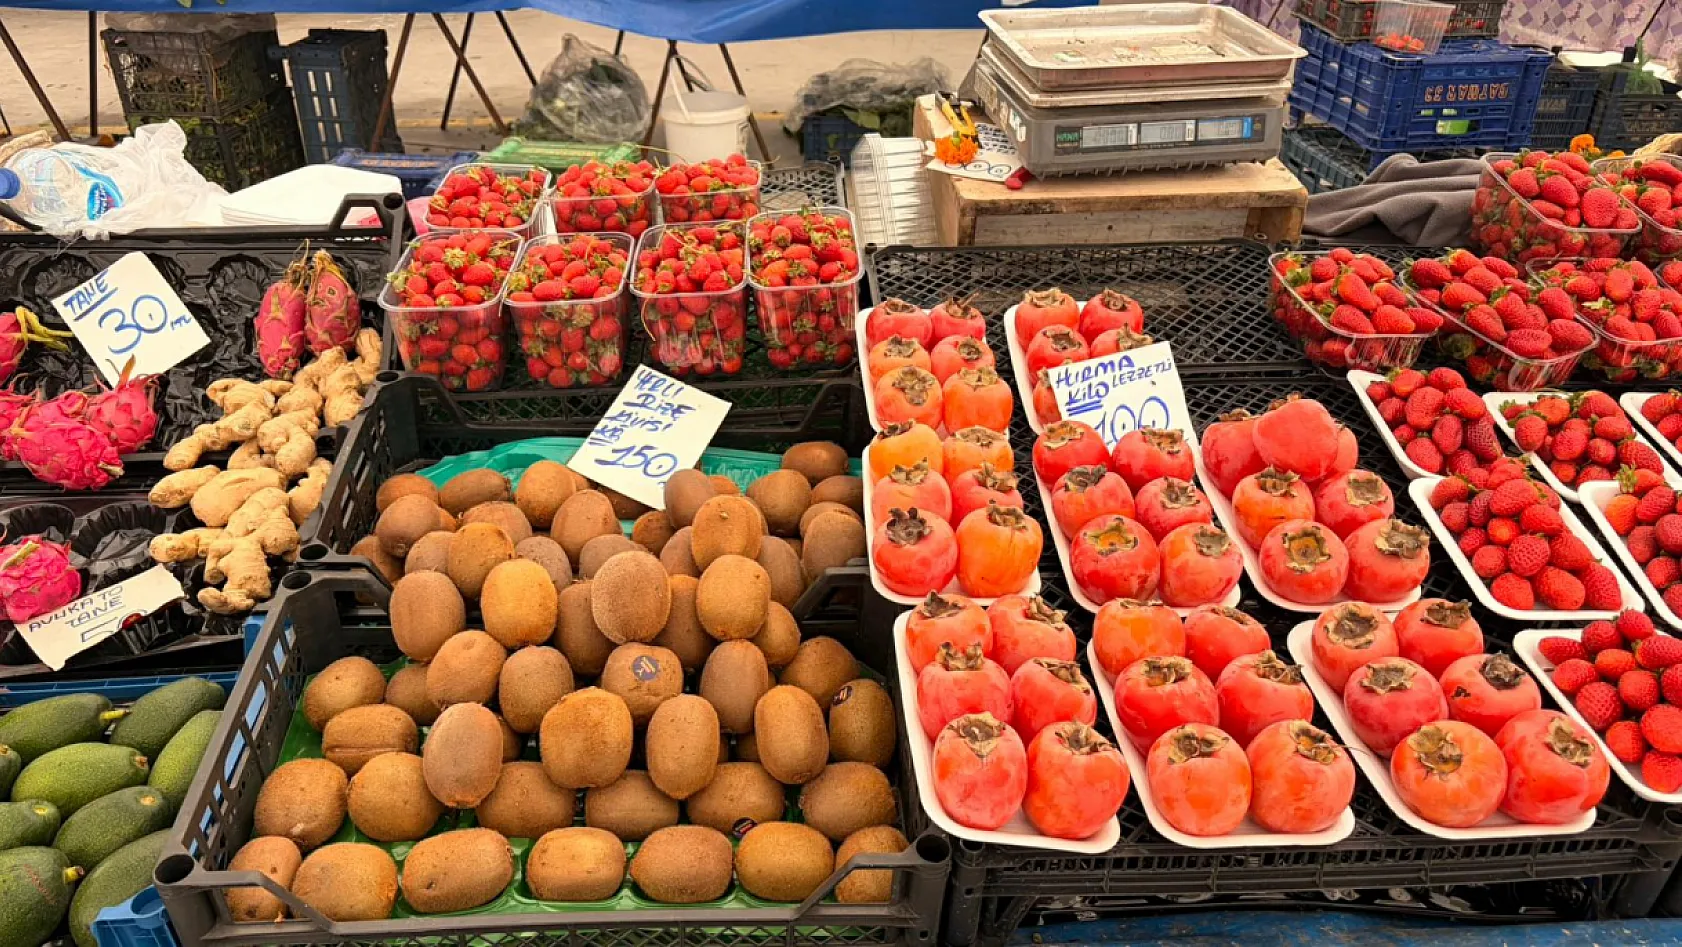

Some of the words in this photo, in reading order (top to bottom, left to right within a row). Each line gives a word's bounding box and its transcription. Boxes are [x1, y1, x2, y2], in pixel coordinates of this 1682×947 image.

[64, 268, 109, 314] TANE
[98, 294, 167, 354] 30
[1094, 395, 1170, 446] 100
[594, 444, 678, 478] 150
[64, 595, 123, 628] TANE
